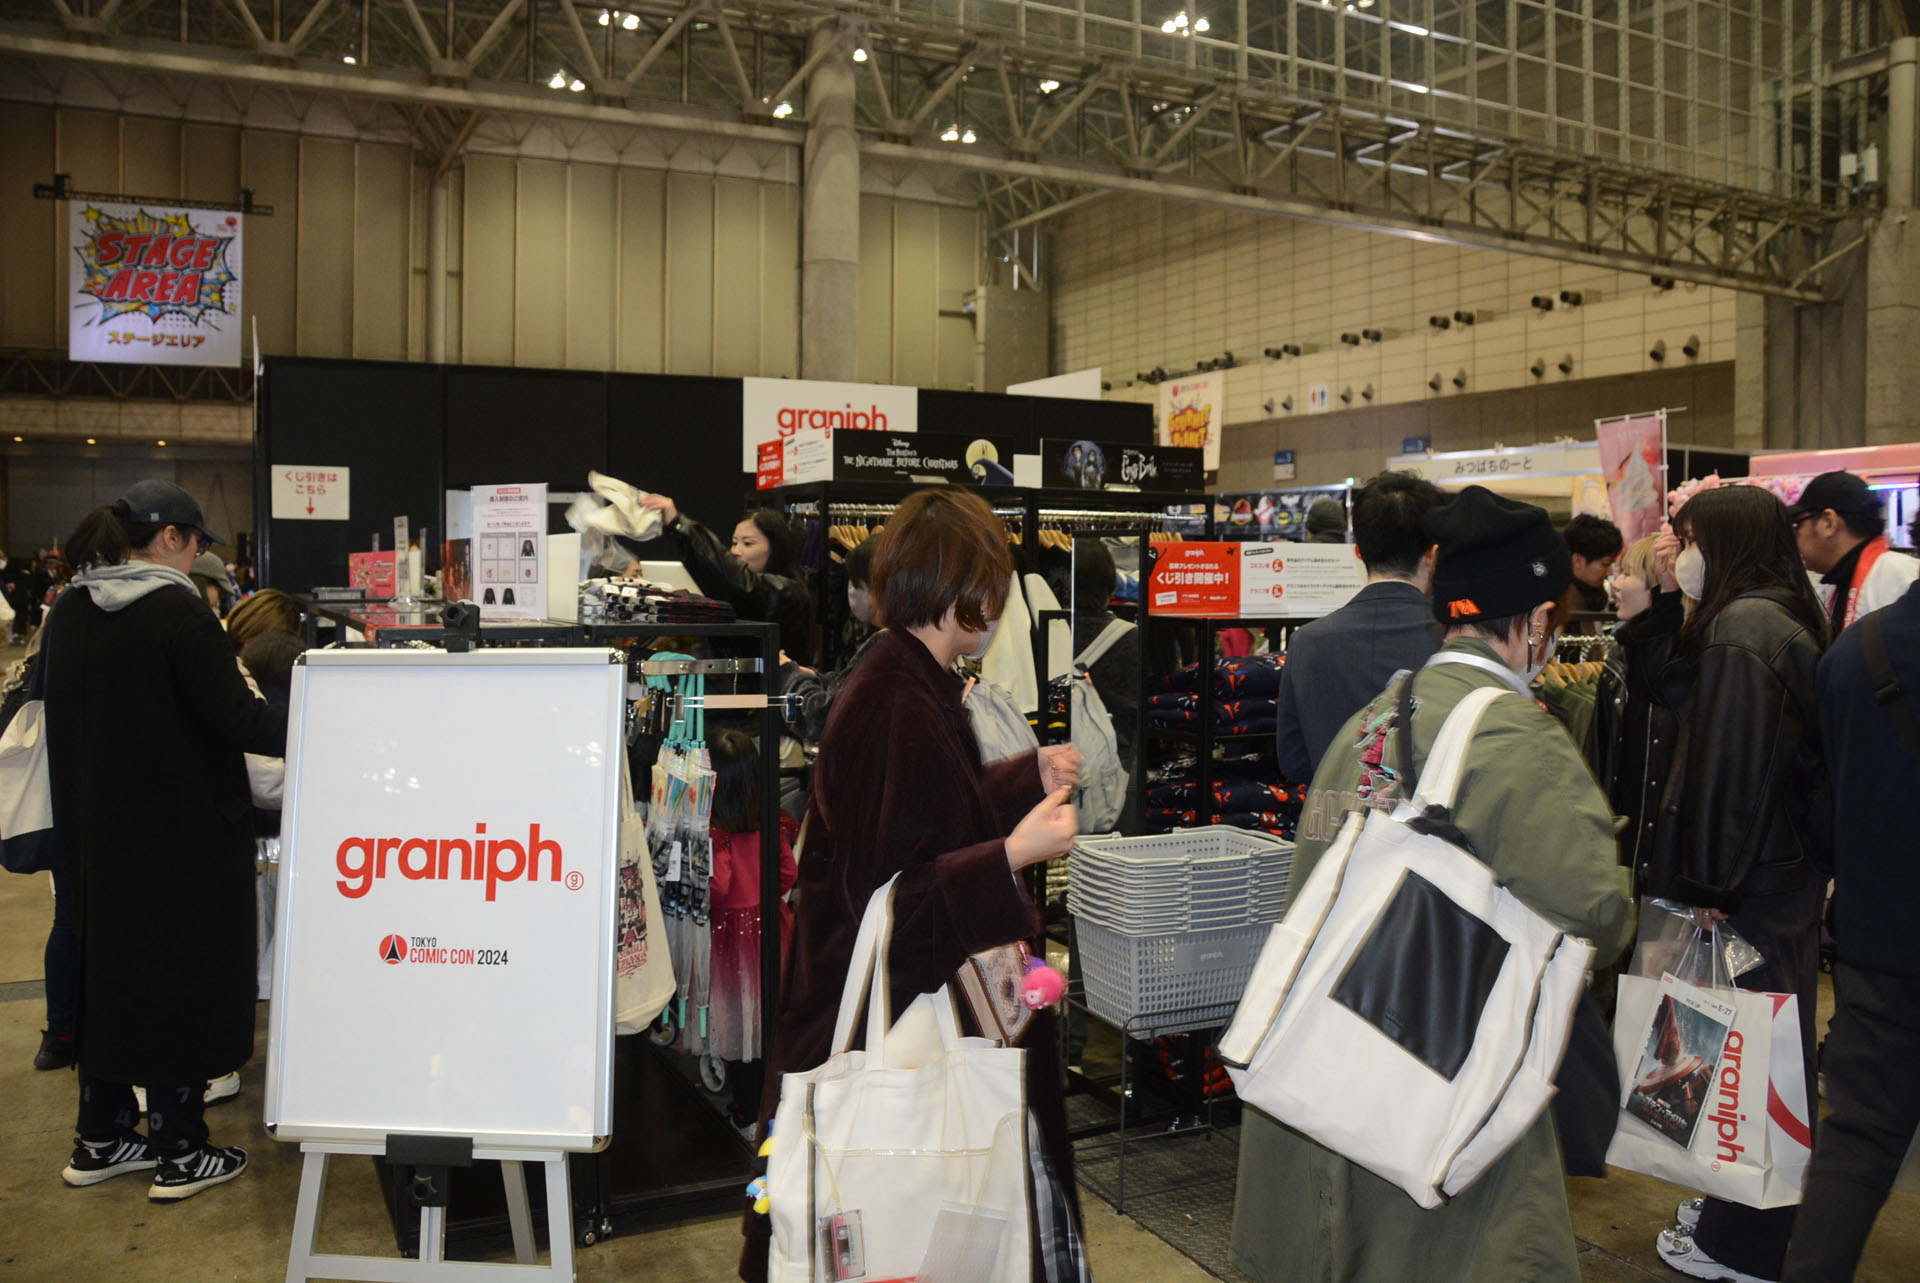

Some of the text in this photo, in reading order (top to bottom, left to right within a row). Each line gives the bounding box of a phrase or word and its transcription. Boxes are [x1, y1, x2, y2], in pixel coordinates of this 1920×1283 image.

[97, 232, 218, 270] STAGE
[103, 267, 201, 305] AREA
[107, 331, 206, 348] ステージエリア
[1454, 456, 1534, 475] みつばちのーと
[284, 470, 339, 483] くじ引きは
[295, 484, 327, 496] こちら
[335, 822, 563, 902] graniph
[410, 936, 437, 948] TOKYO
[409, 947, 508, 966] COMIC CON 2024
